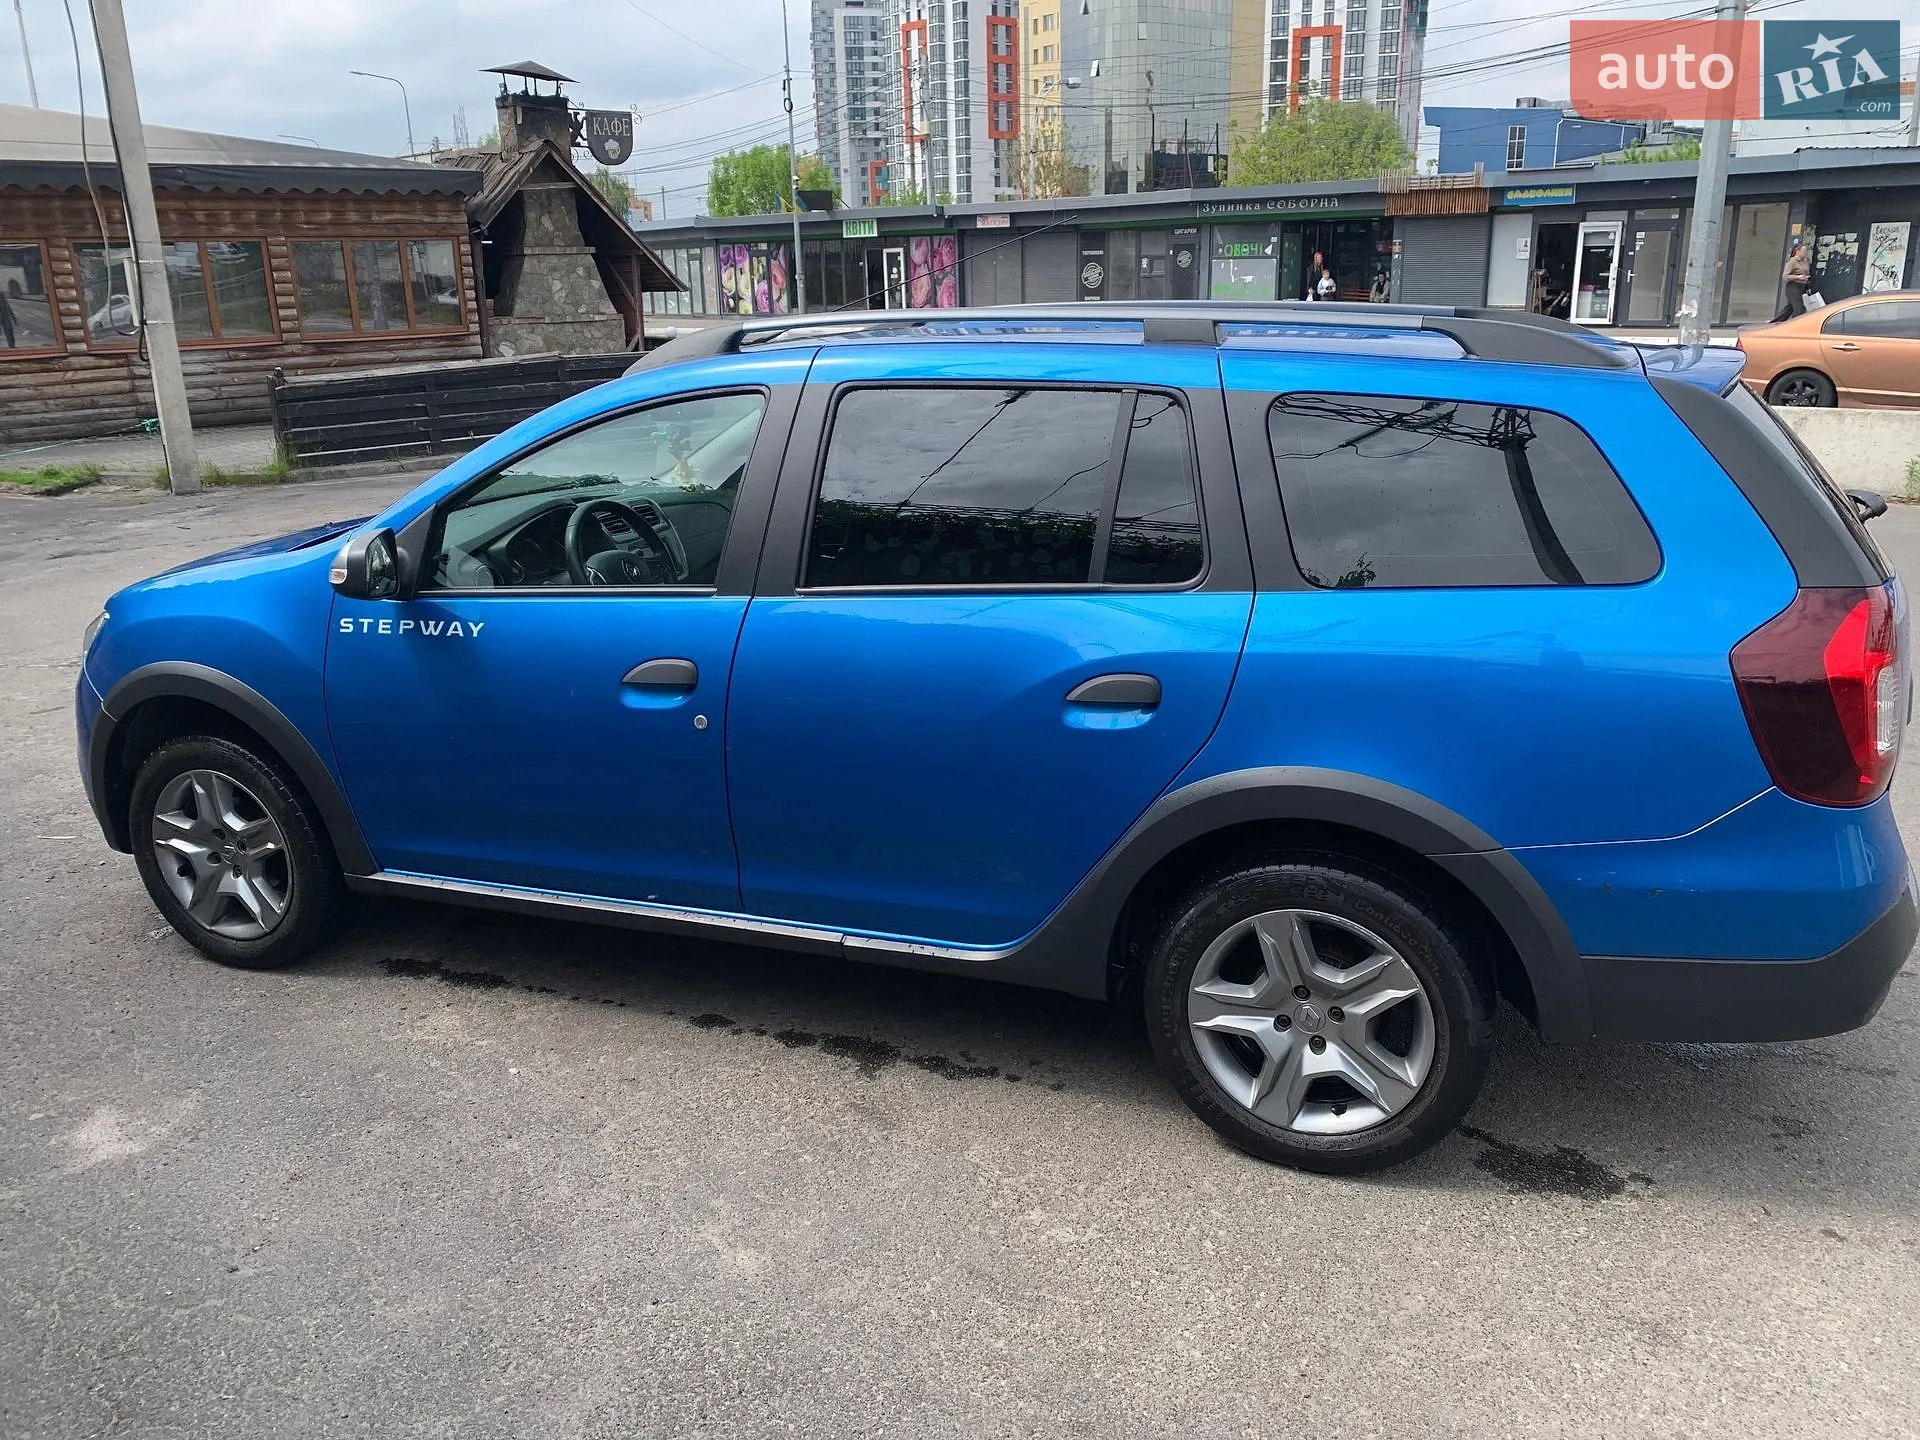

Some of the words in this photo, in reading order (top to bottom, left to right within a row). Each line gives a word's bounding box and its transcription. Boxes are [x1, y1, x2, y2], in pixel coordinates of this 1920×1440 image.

[593, 117, 631, 137] КАФЕ
[1202, 202, 1261, 214] Зупинка
[1266, 197, 1340, 211] СОБОРНА
[845, 220, 875, 237] КВІТИ
[1224, 243, 1263, 257] ОВОЧІ
[339, 617, 485, 638] STEPWAY
